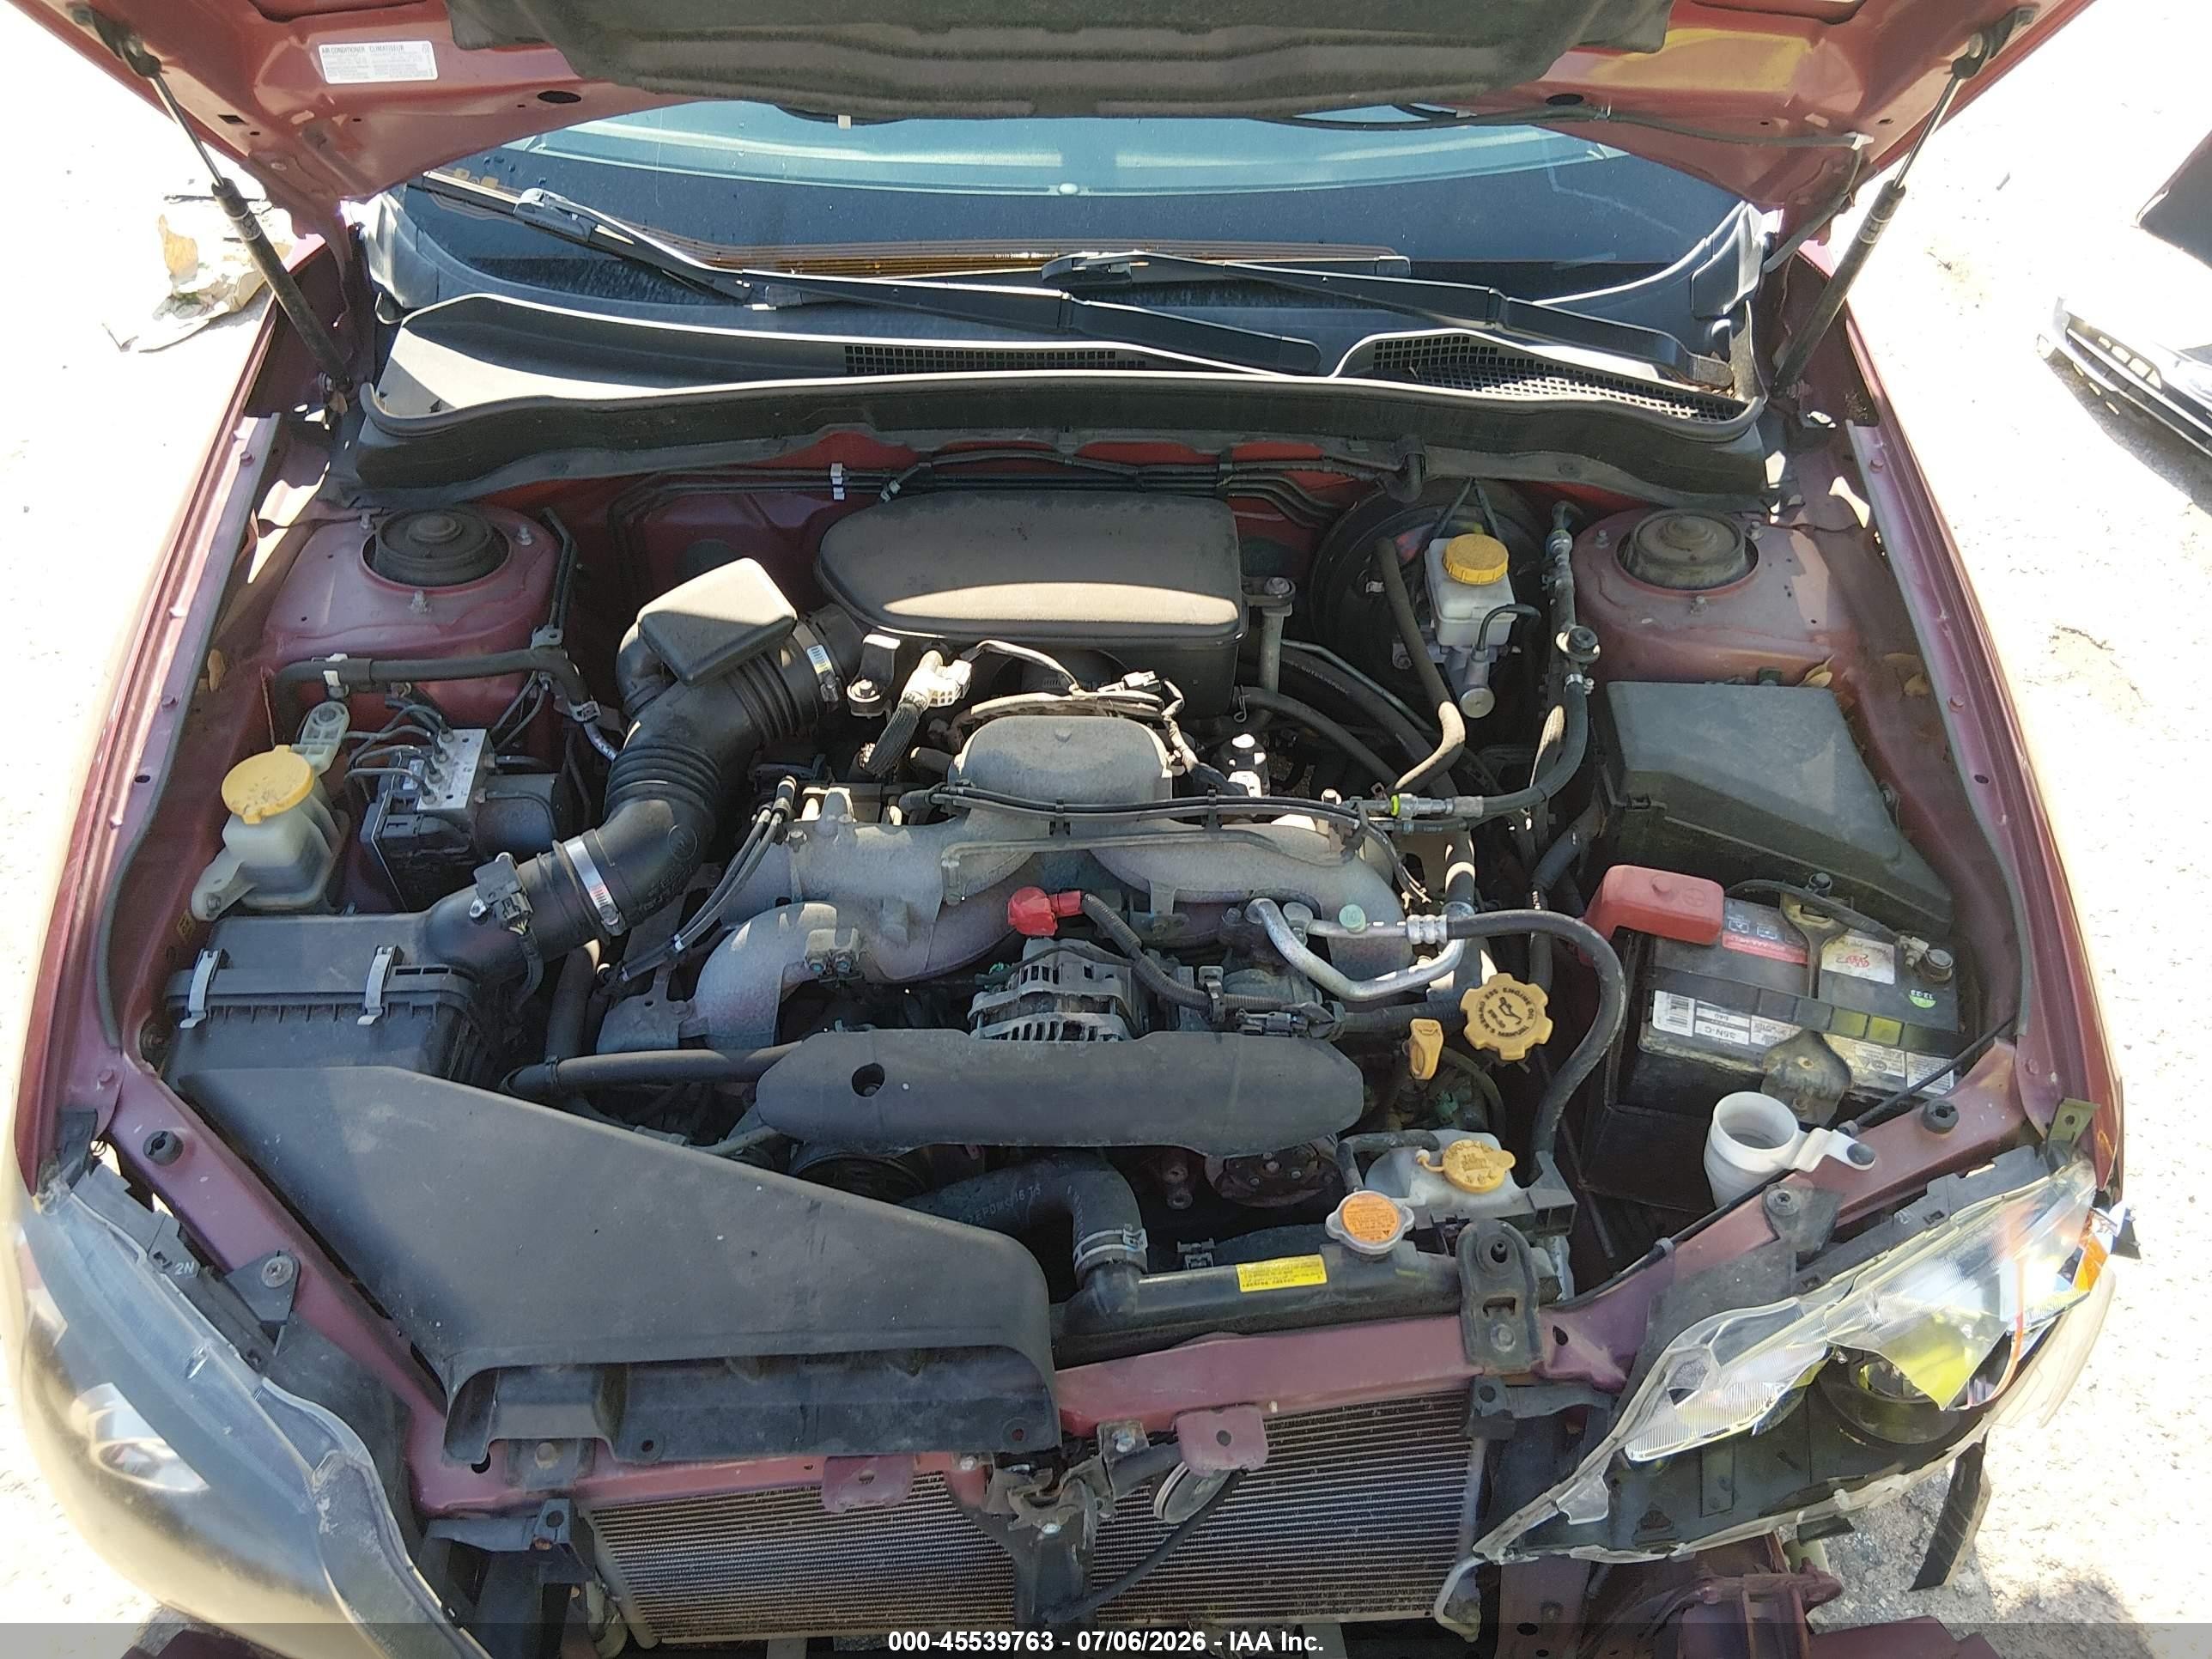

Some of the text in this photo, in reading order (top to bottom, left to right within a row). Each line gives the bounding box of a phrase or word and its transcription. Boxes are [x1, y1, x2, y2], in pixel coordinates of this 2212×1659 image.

[369, 45, 404, 53] CLIMATISEUR
[1503, 988, 1531, 1006] ENGINE
[1485, 988, 1498, 1000] SEE
[1498, 1025, 1529, 1037] MANUAL
